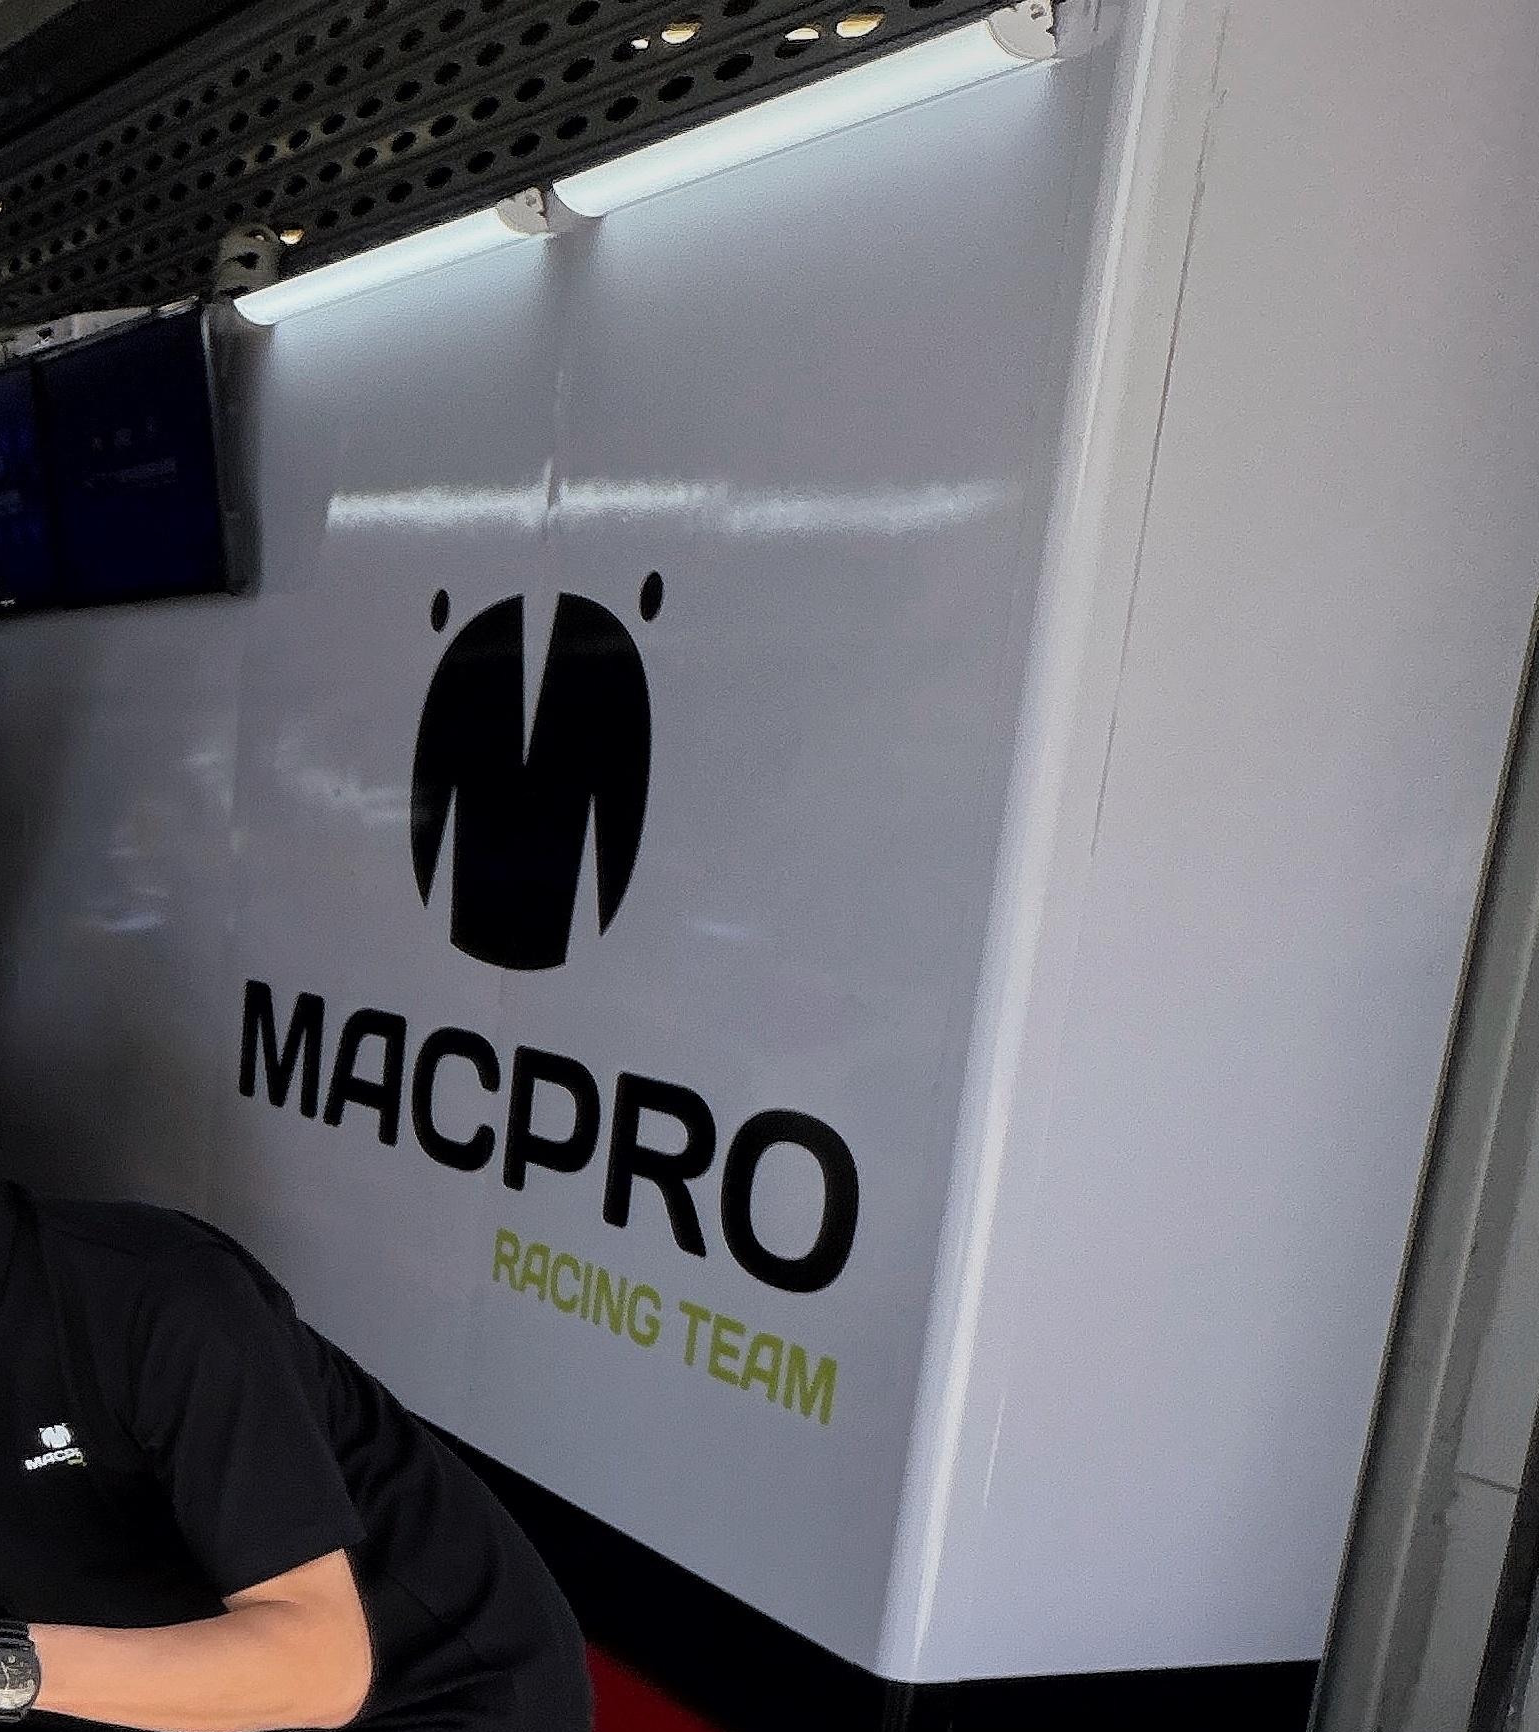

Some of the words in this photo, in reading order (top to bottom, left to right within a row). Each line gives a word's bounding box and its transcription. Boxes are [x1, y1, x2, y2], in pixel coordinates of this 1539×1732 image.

[238, 980, 860, 1294] MACPRO
[492, 1228, 662, 1348] RACING
[678, 1299, 838, 1426] TEAM
